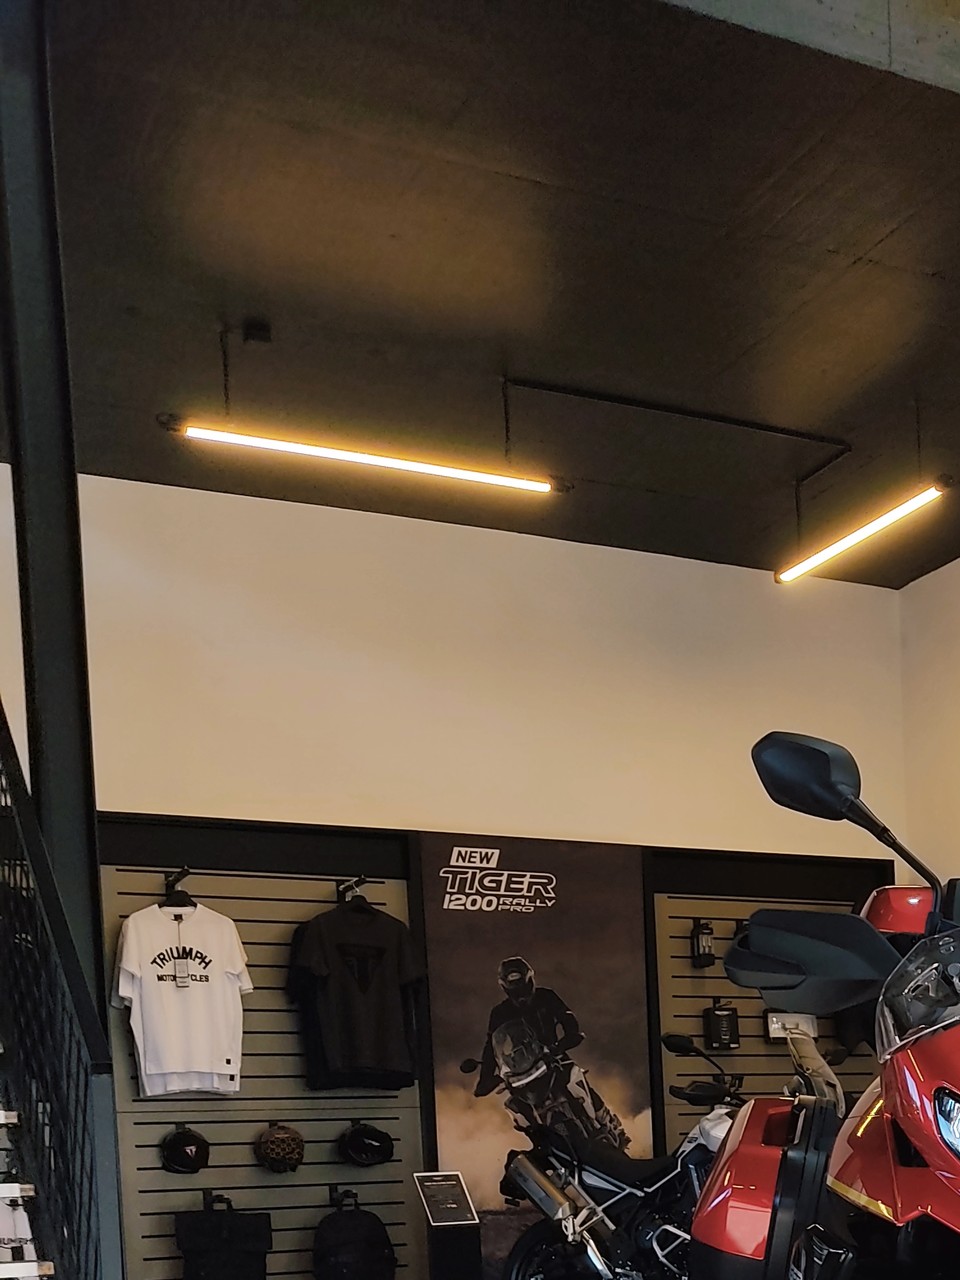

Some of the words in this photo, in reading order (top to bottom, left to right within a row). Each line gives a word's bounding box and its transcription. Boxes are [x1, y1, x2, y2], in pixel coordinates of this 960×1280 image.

[455, 850, 495, 865] NEW
[439, 867, 557, 898] TIGER
[443, 894, 498, 911] 1200
[499, 897, 556, 907] RALLY
[498, 905, 534, 913] PRO
[150, 946, 213, 970] TRIUMPH
